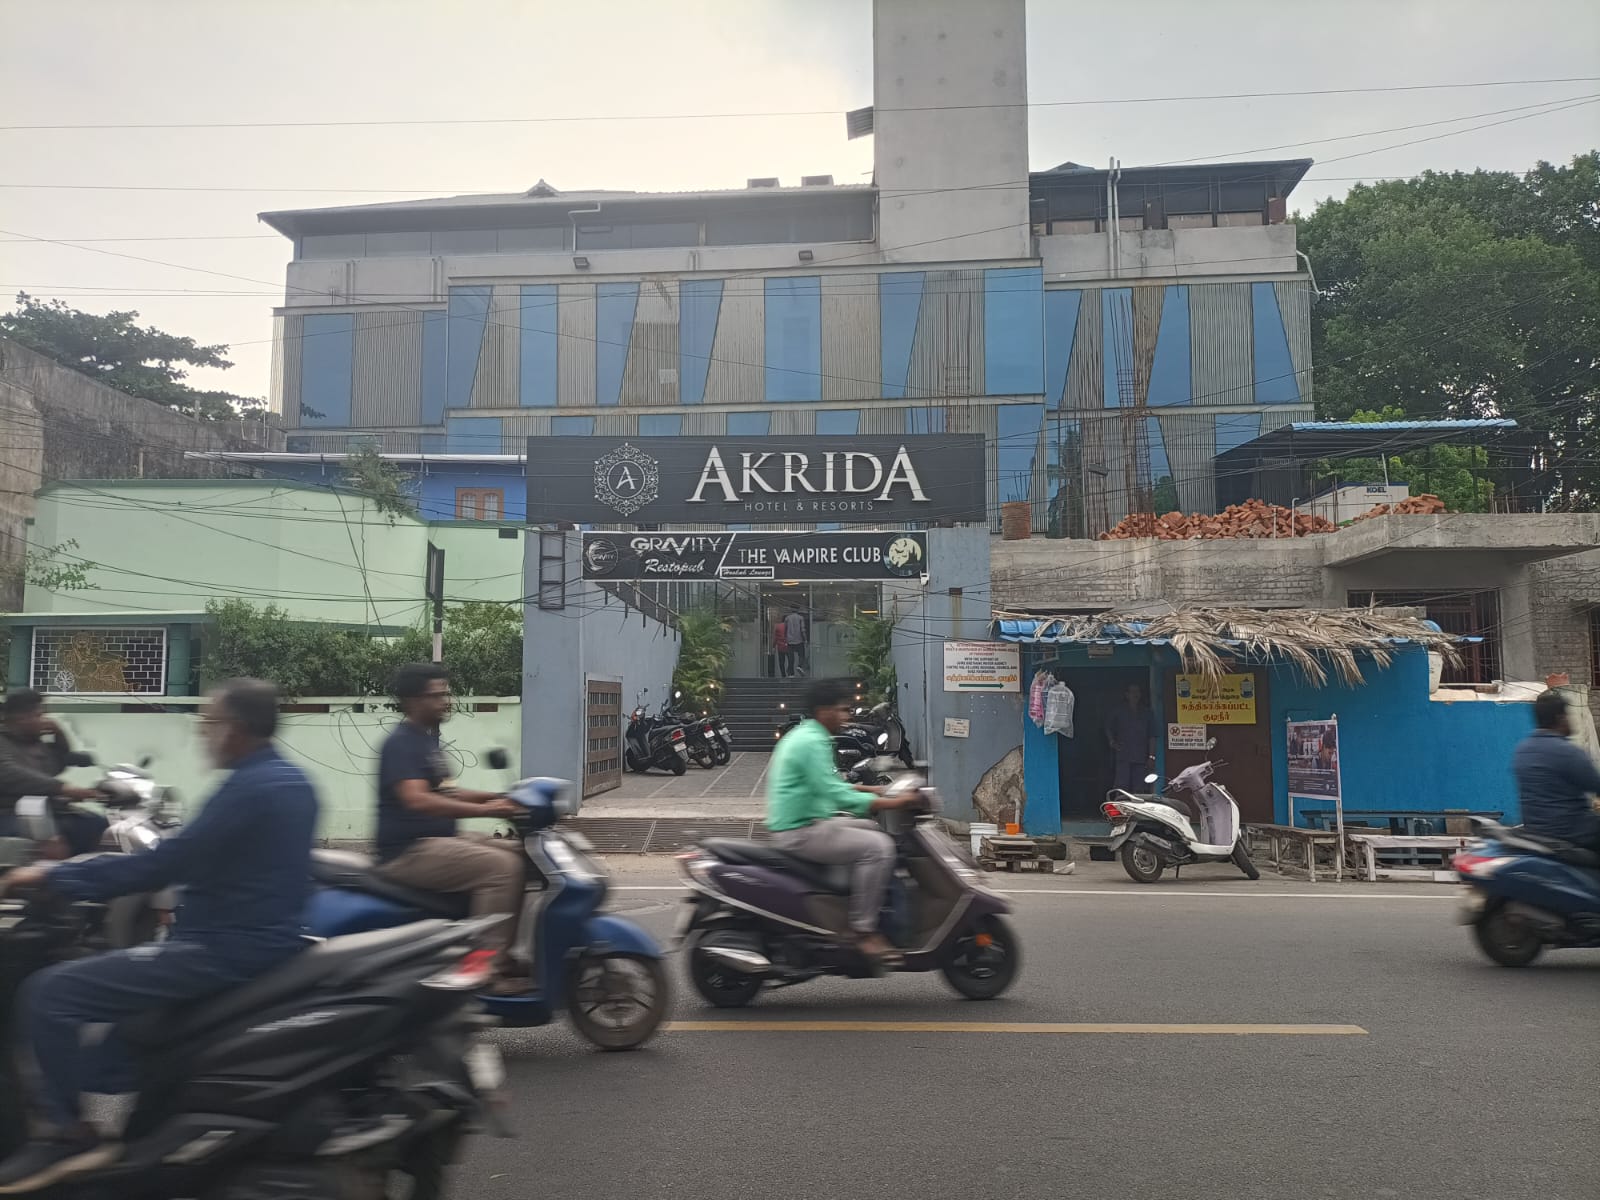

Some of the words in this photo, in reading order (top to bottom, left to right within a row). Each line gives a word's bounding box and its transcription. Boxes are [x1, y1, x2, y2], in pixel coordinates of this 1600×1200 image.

[686, 445, 932, 501] AKRIDA
[745, 502, 788, 512] HOTEL
[797, 502, 804, 511] &
[813, 501, 874, 511] RESORTS
[630, 537, 722, 557] GRAVITY
[738, 548, 767, 564] THE
[773, 547, 838, 564] VAMPIRE
[842, 547, 881, 563] CLUB
[644, 558, 706, 575] Restopub
